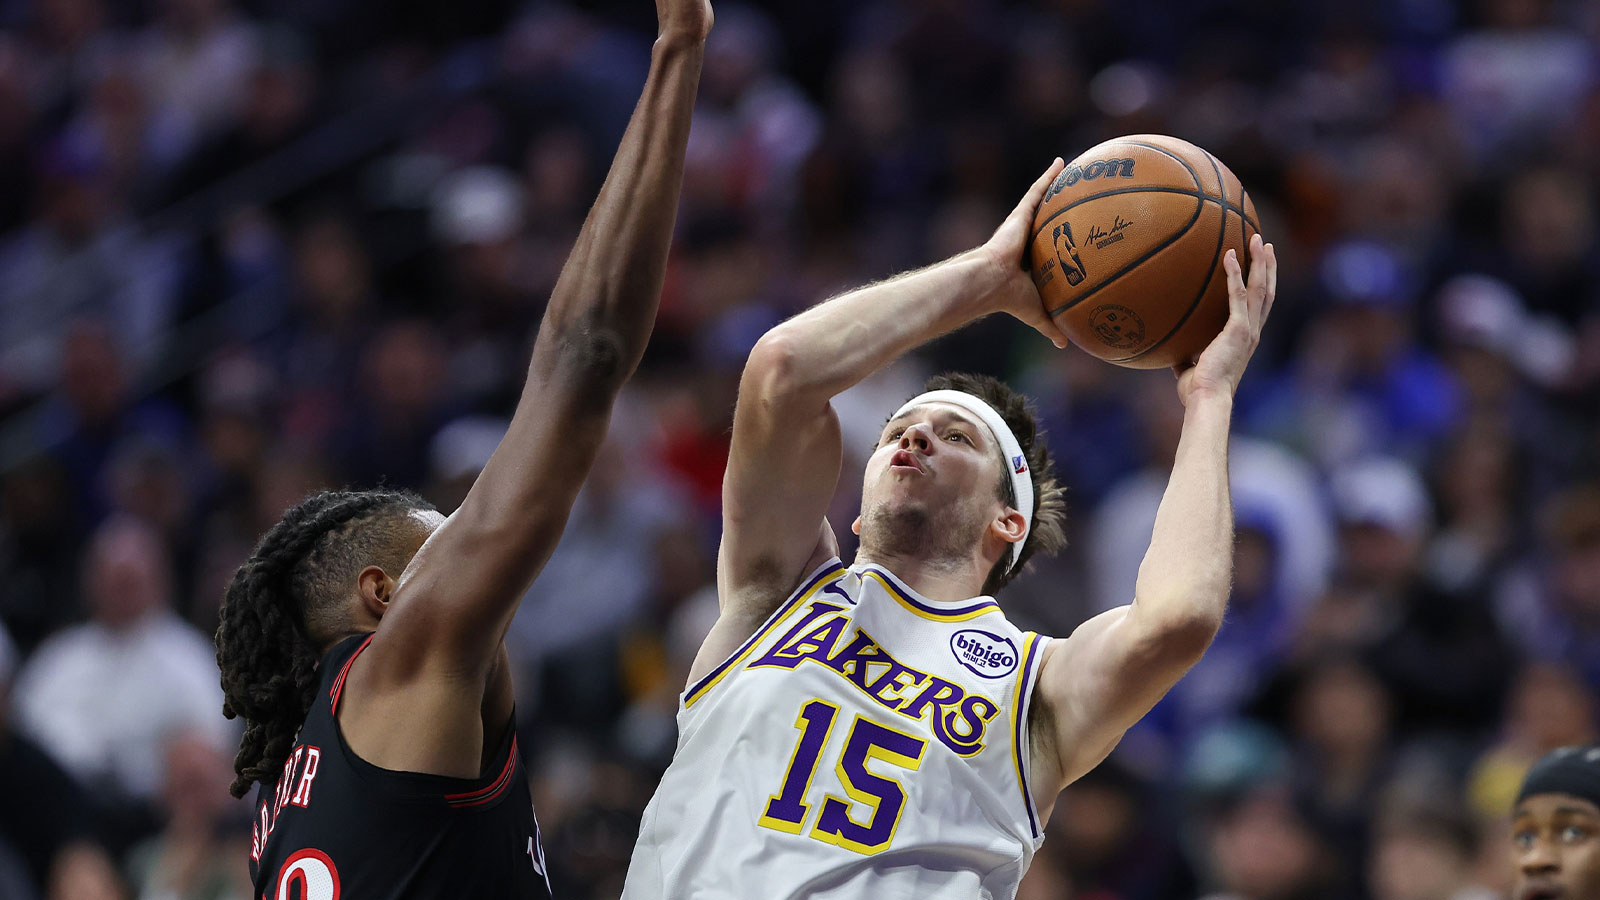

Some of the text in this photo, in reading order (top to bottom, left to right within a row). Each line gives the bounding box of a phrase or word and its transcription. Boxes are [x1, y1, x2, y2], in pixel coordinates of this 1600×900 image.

[743, 601, 1001, 758] LAKERS
[956, 634, 1014, 668] bibigo
[962, 651, 987, 668] 비비고
[757, 697, 930, 856] 15
